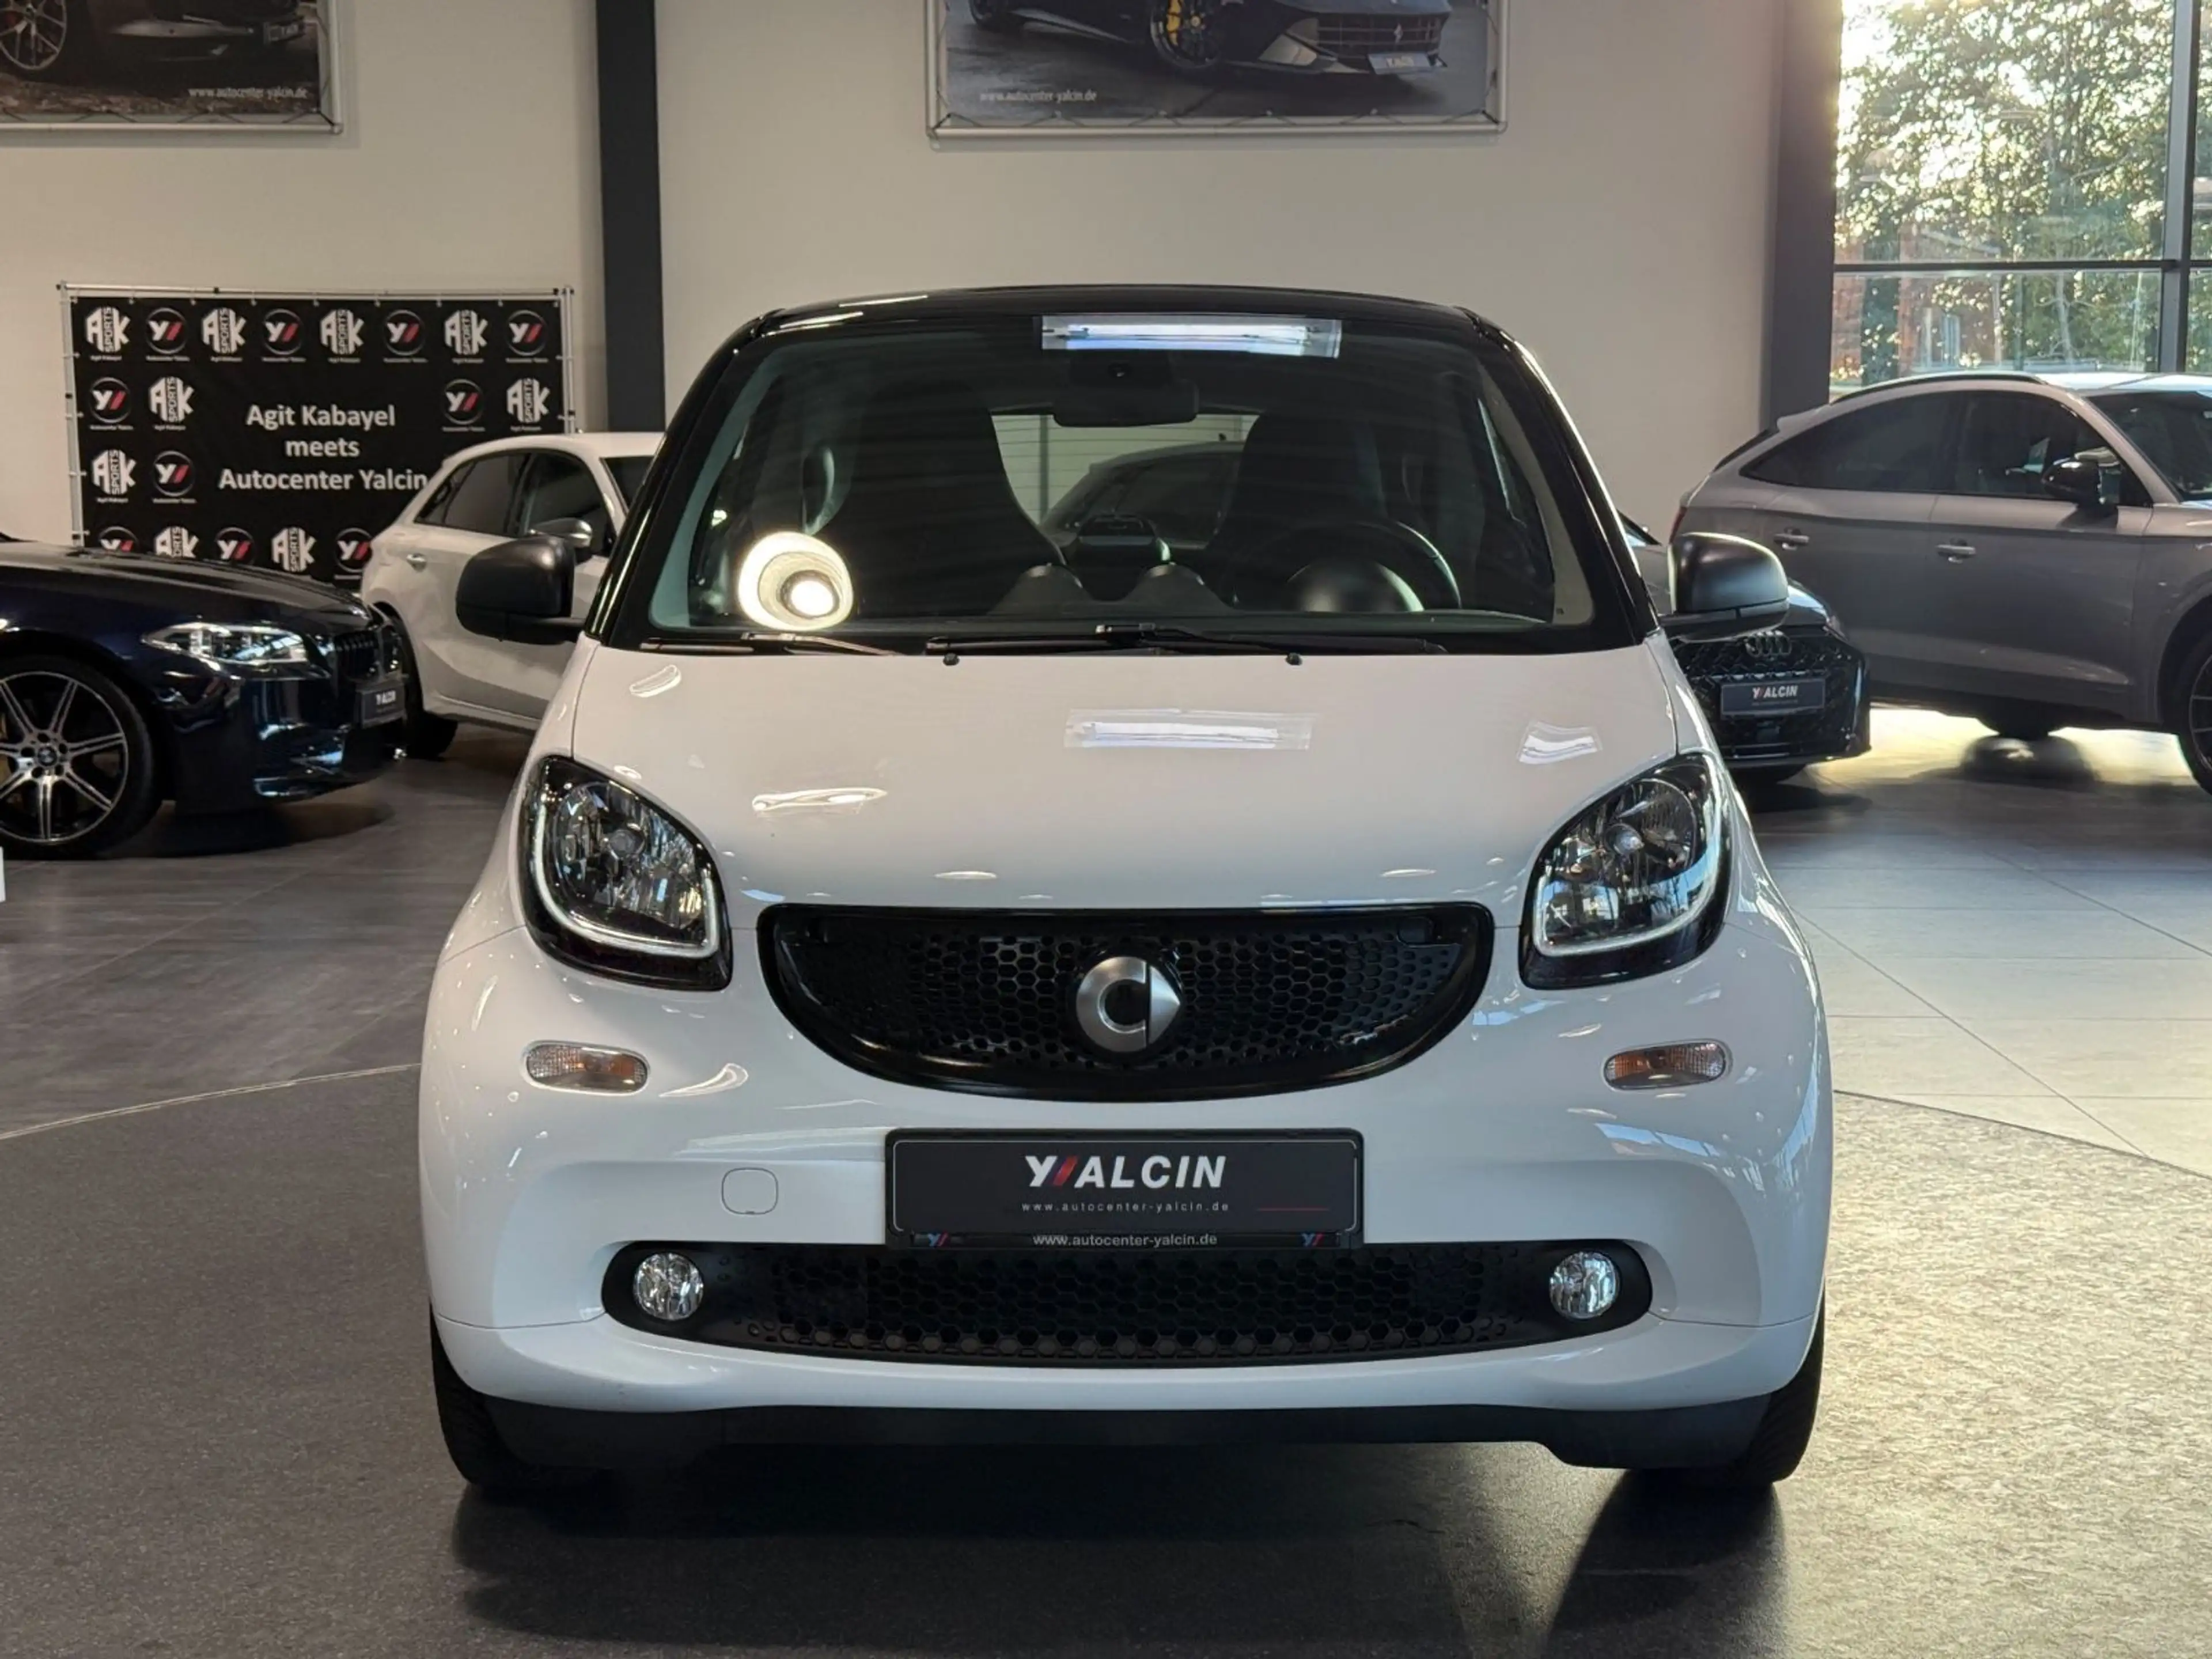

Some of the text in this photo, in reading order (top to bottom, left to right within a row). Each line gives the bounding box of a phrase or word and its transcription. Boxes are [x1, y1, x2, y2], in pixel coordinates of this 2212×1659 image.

[246, 404, 396, 431] Agit Kabayel
[286, 438, 360, 457] meets
[218, 468, 427, 490] Autocenter Yalcin
[172, 527, 183, 557] ORTS
[1021, 1200, 1229, 1214] www.autocenter-yalcin.de
[1032, 1233, 1218, 1249] www.autocenter-yalcin.de
